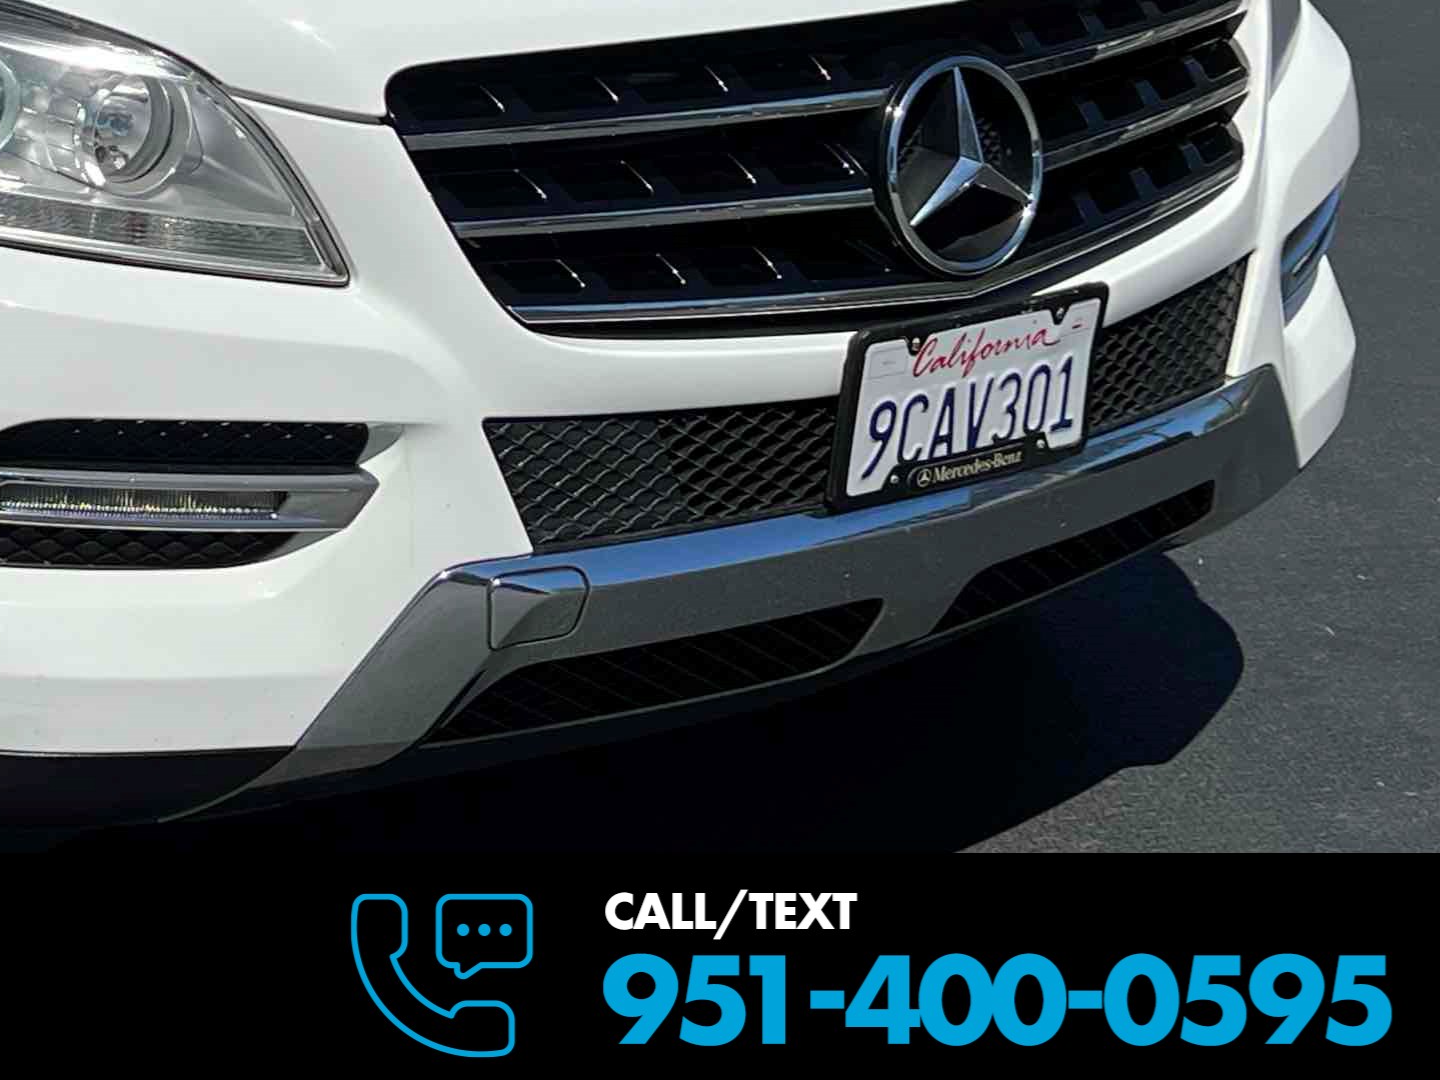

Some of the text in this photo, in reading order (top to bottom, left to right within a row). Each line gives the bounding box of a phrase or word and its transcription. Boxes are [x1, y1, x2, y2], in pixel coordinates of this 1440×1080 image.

[912, 328, 1058, 377] California
[860, 355, 1074, 480] 9CAV301
[931, 451, 1023, 483] Mercedes-Benz
